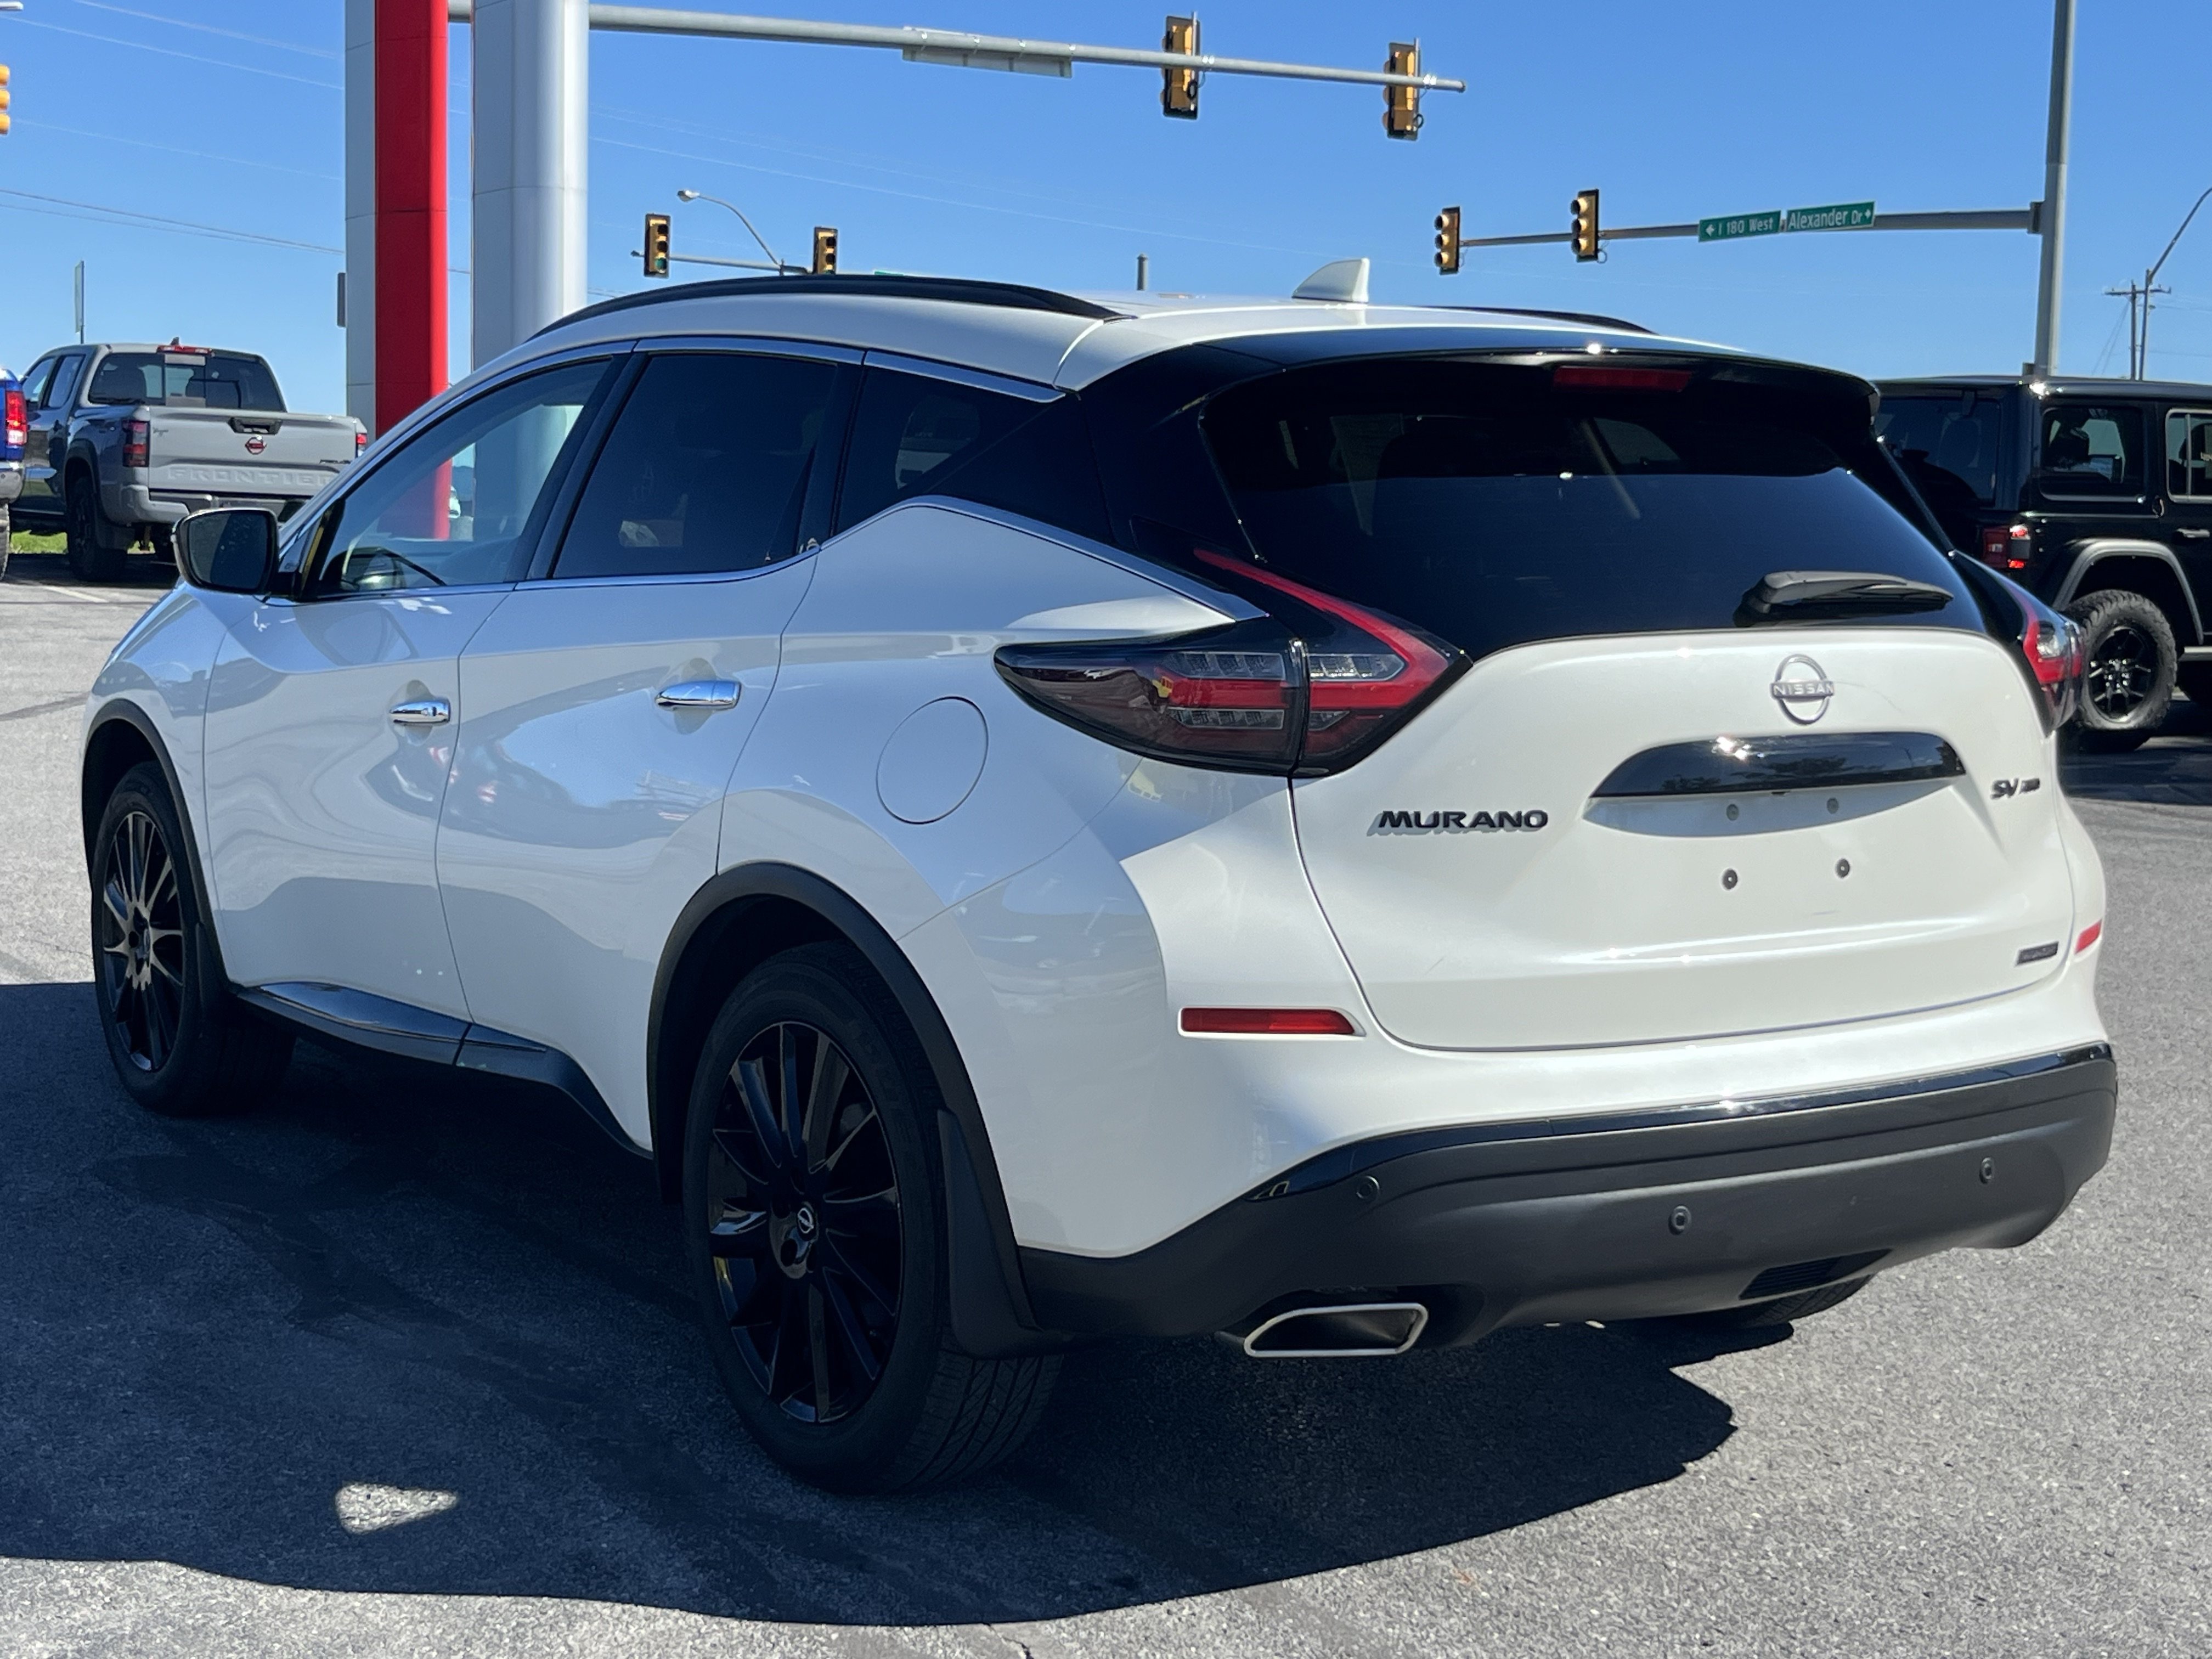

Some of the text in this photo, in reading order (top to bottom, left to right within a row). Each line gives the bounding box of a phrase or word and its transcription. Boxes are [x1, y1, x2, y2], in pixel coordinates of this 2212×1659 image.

[1726, 220, 1745, 235] 180
[1749, 217, 1773, 232] West
[1788, 208, 1863, 229] Alexander Dr
[1773, 681, 1833, 696] NISSAN
[1376, 809, 1549, 830] MURANO
